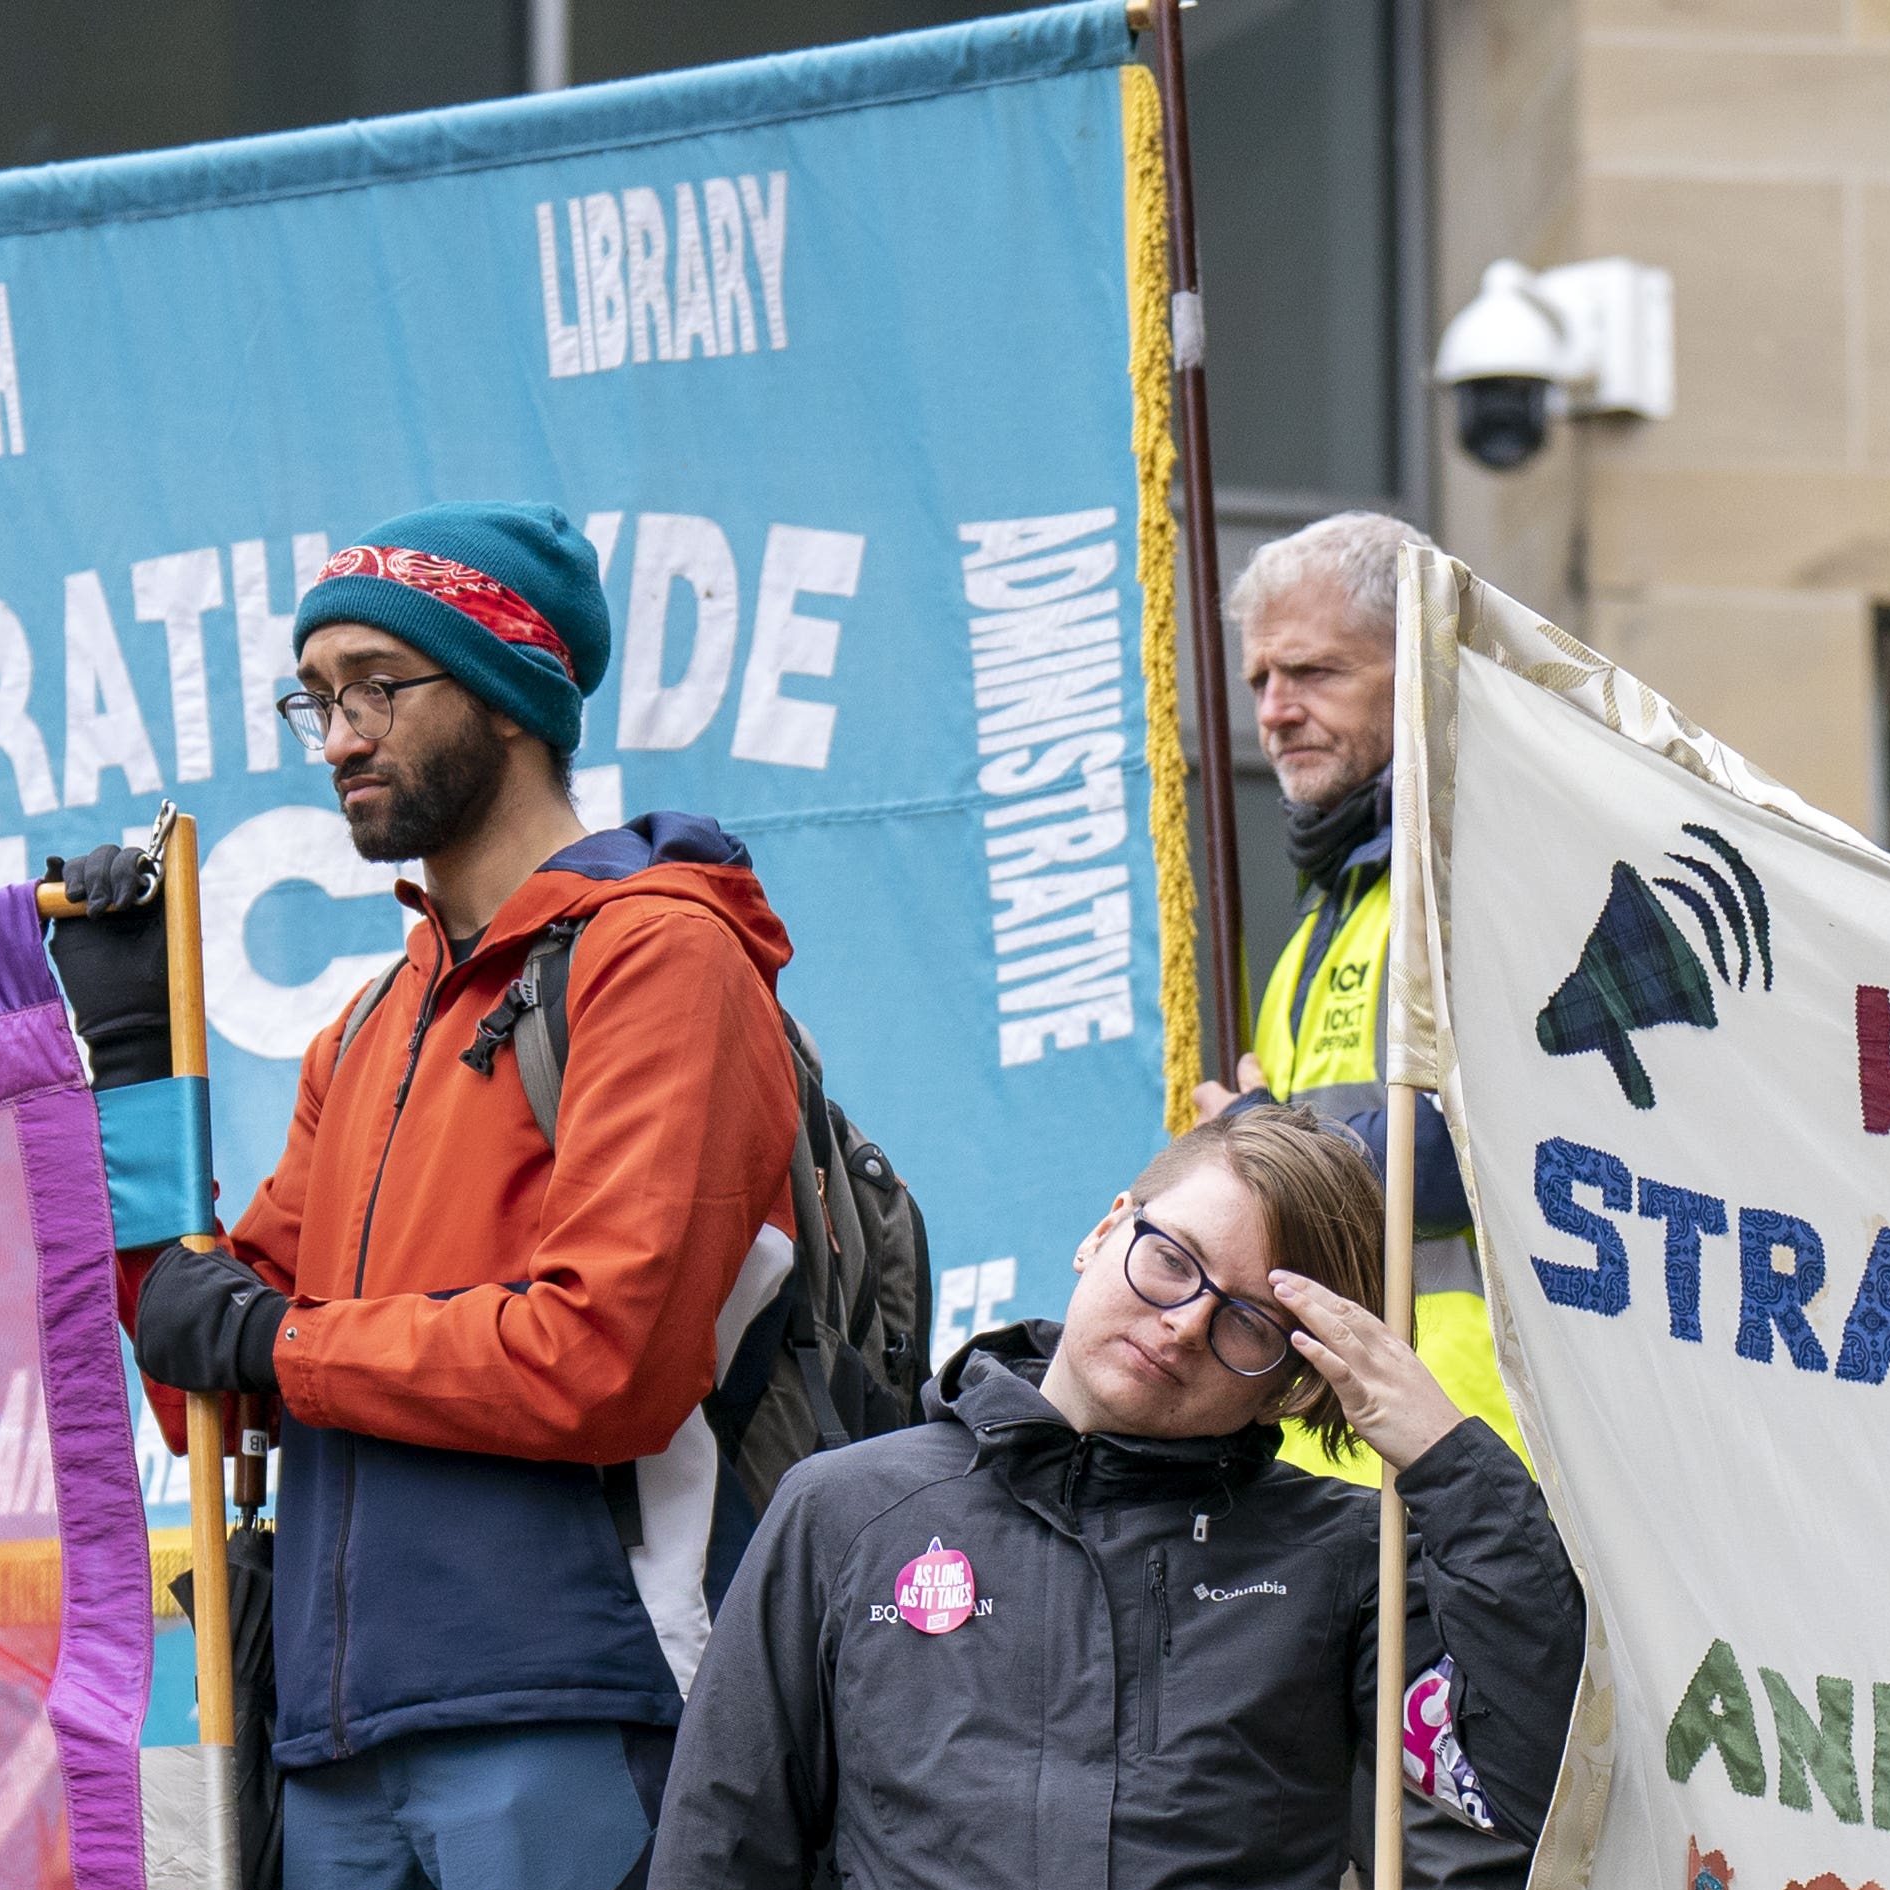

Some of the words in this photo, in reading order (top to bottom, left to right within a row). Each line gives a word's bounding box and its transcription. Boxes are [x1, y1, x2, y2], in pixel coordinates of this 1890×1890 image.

[536, 170, 788, 378] LIBRARY
[958, 507, 1134, 1068] ADMINISTRATIVE
[912, 1564, 932, 1587] AS
[934, 1561, 965, 1587] LONG
[899, 1584, 919, 1607] AS
[921, 1586, 935, 1610] IT
[937, 1582, 972, 1610] TAKES
[1210, 1580, 1288, 1601] Columbia
